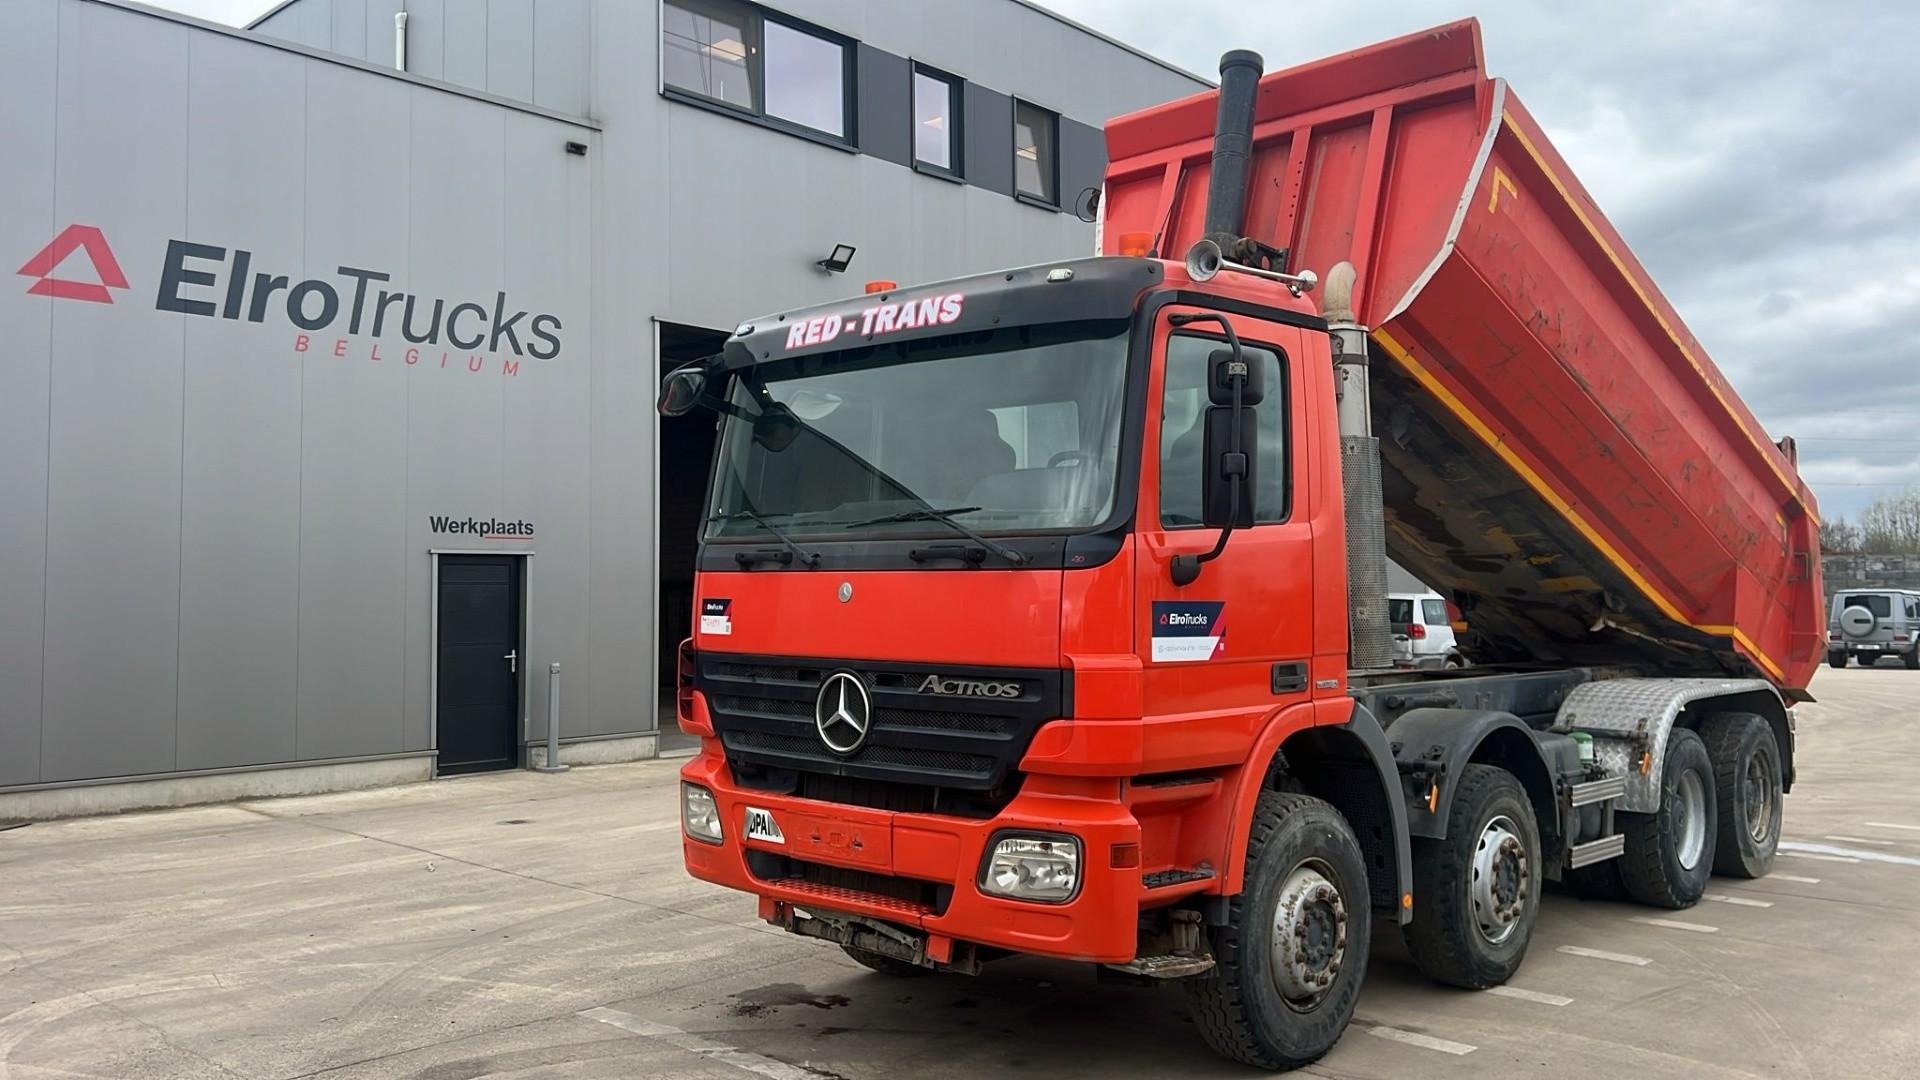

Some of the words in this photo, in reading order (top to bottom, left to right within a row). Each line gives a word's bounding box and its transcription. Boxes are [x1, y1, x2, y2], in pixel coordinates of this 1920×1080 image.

[155, 239, 562, 360] ElroTrucks
[785, 314, 842, 350] RED
[861, 293, 963, 336] TRANS
[295, 335, 519, 377] BELGIUM
[429, 516, 534, 537] Werkplaats
[1169, 613, 1208, 625] ElroTrucks
[918, 674, 1020, 698] ACTROS
